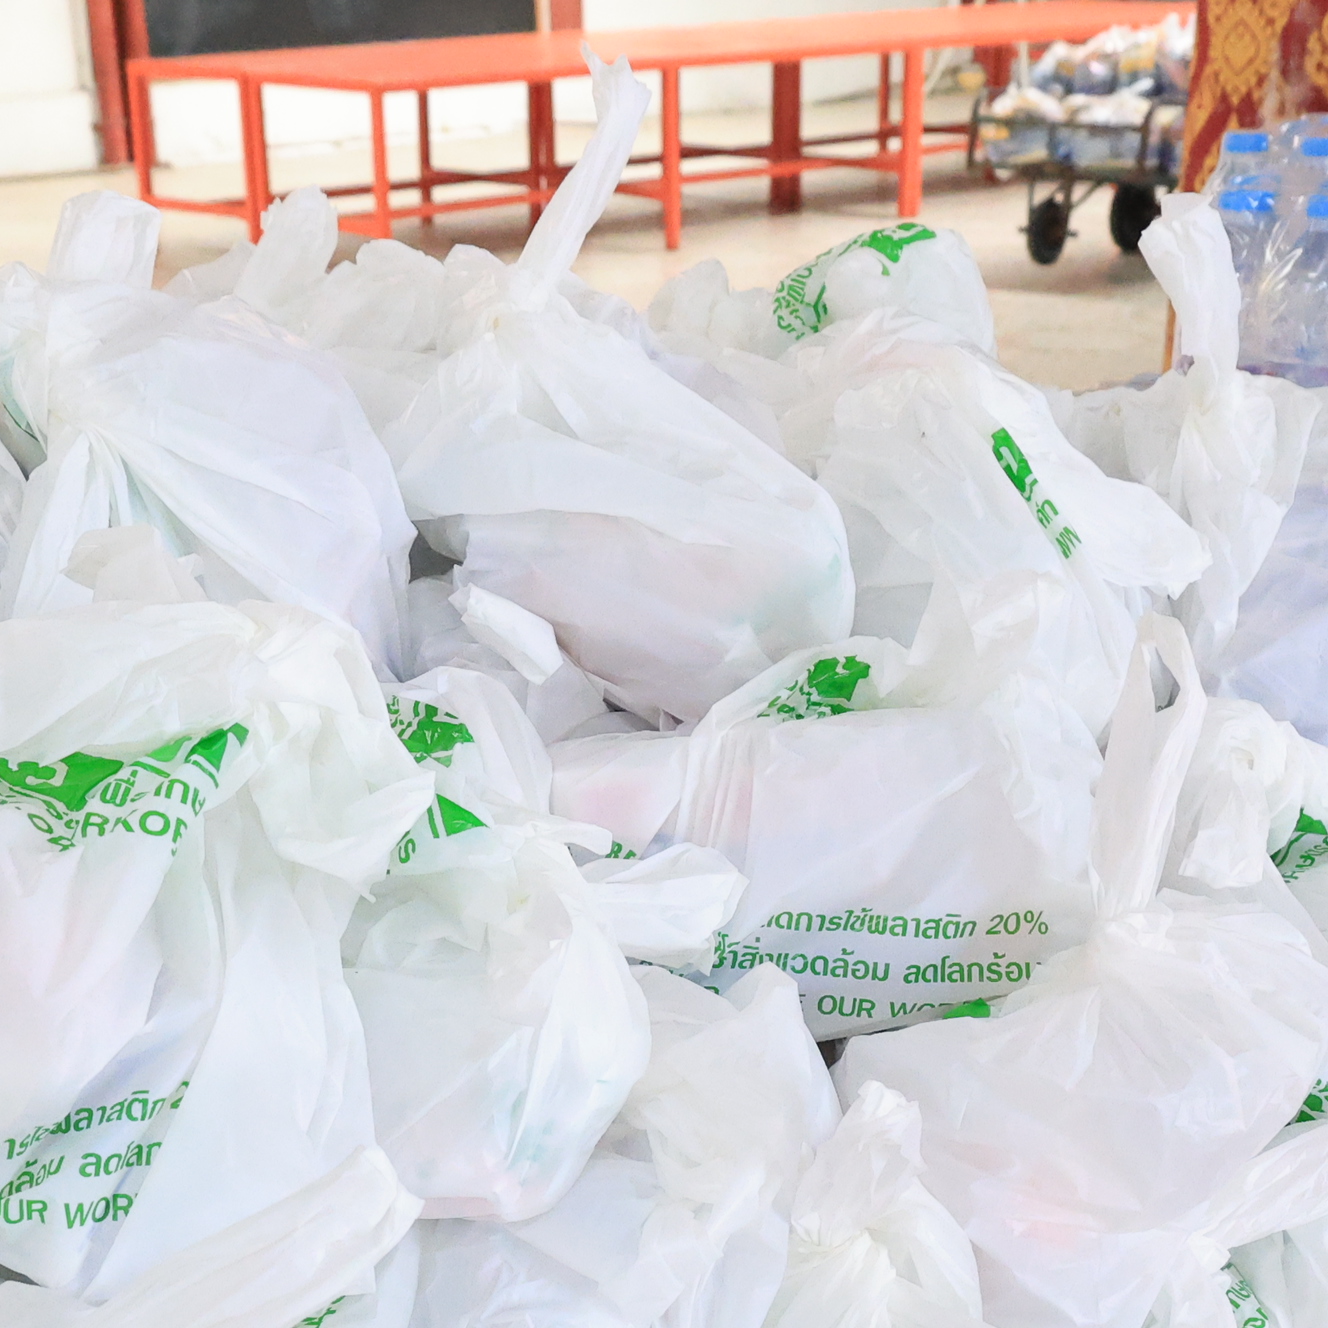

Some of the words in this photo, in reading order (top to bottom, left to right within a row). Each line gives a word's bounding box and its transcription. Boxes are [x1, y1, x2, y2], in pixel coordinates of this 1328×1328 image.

[985, 910, 1049, 936] 20%
[817, 995, 876, 1019] OUR
[64, 1193, 139, 1230] WOR
